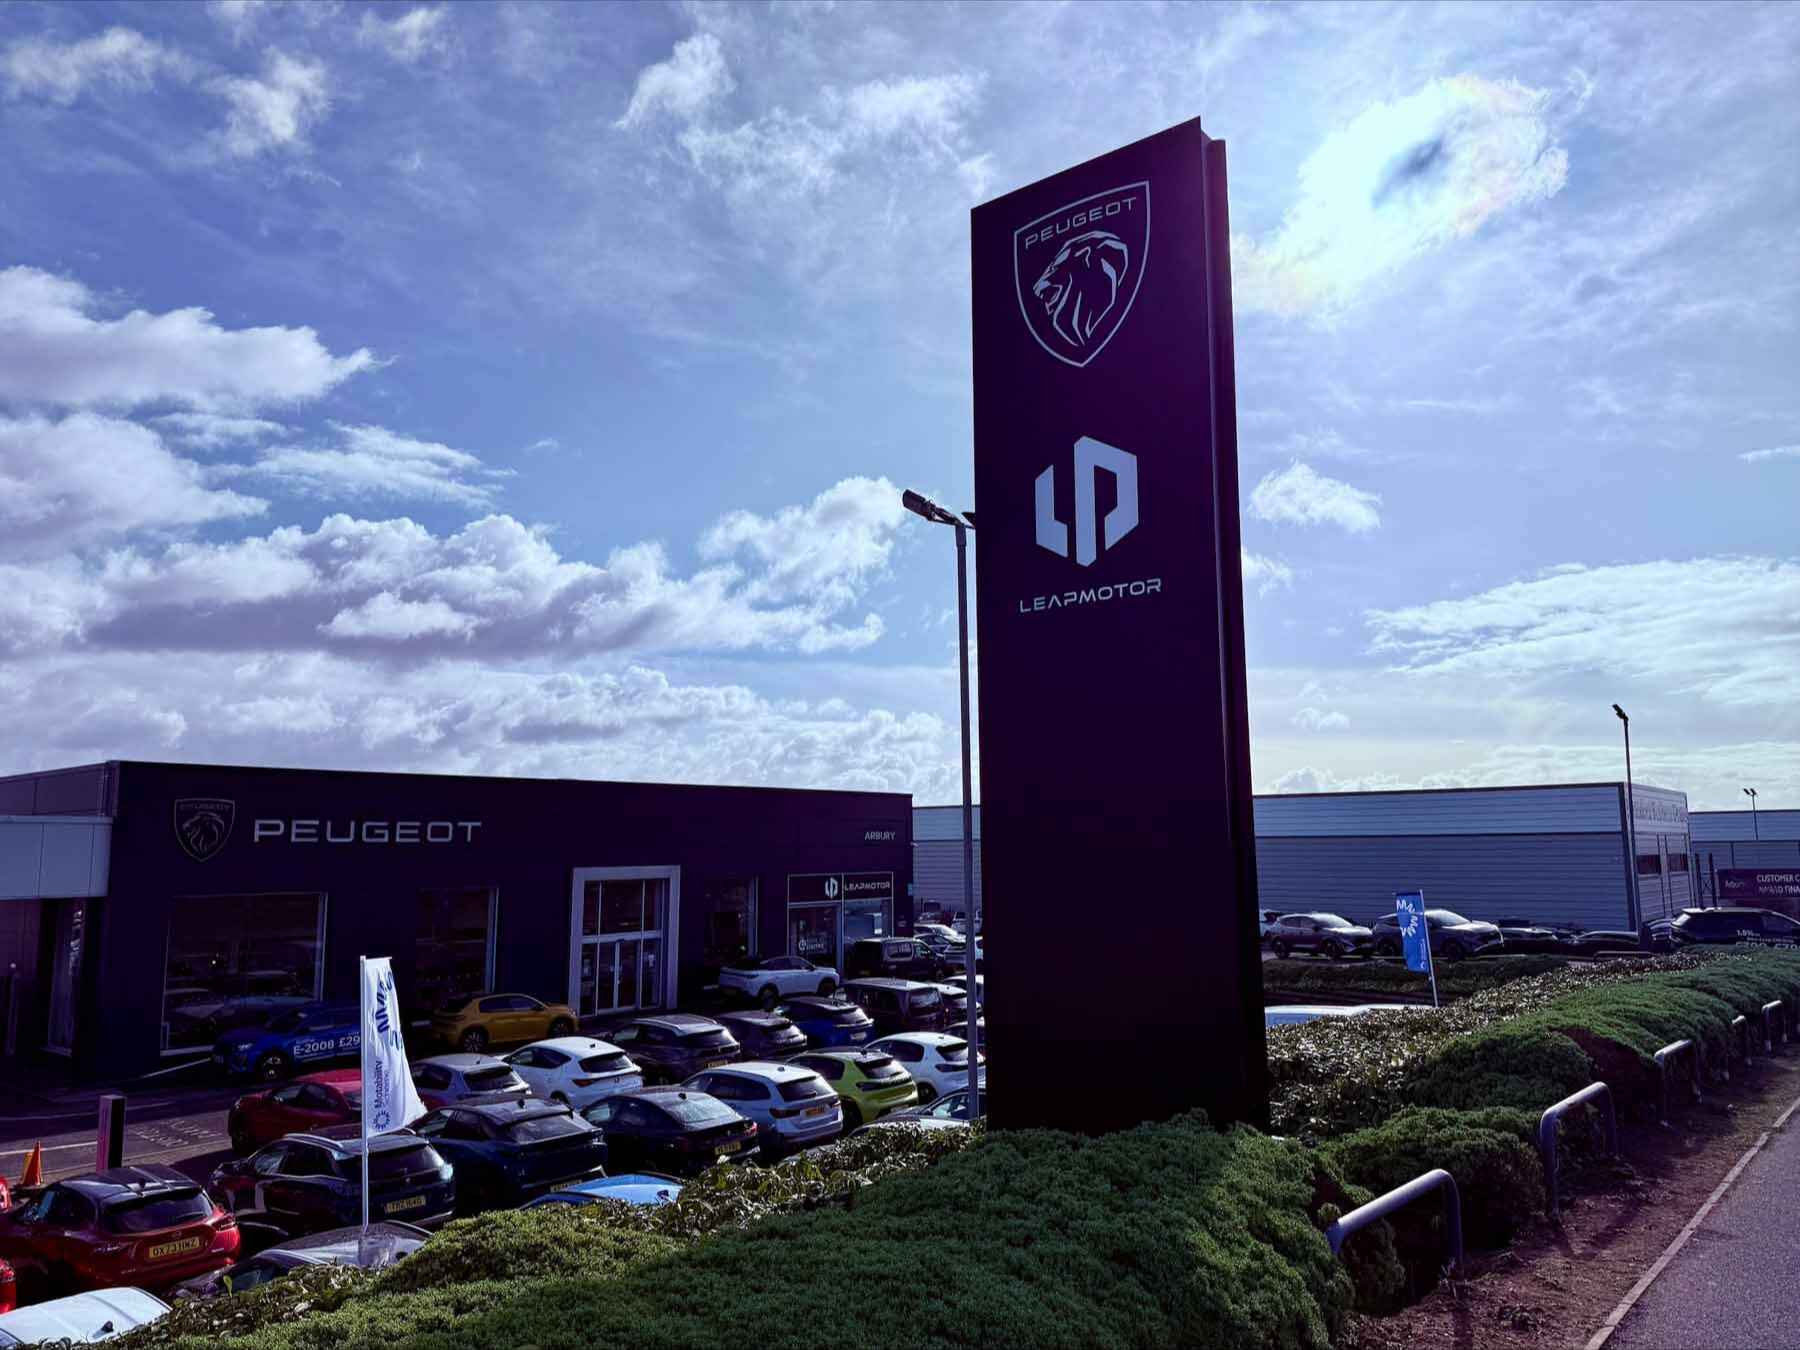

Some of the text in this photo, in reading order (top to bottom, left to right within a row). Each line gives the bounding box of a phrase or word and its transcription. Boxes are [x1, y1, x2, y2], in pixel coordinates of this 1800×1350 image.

[1025, 197, 1136, 249] PEUGEOT
[1020, 578, 1161, 613] LEAPMOTOR
[254, 819, 482, 843] PEUGEOT
[864, 831, 895, 841] ARBURY
[844, 882, 890, 891] LEAPMOTOR
[1756, 874, 1794, 883] CUSTOMER
[294, 1039, 334, 1055] E-2008
[374, 1060, 383, 1109] Motability
